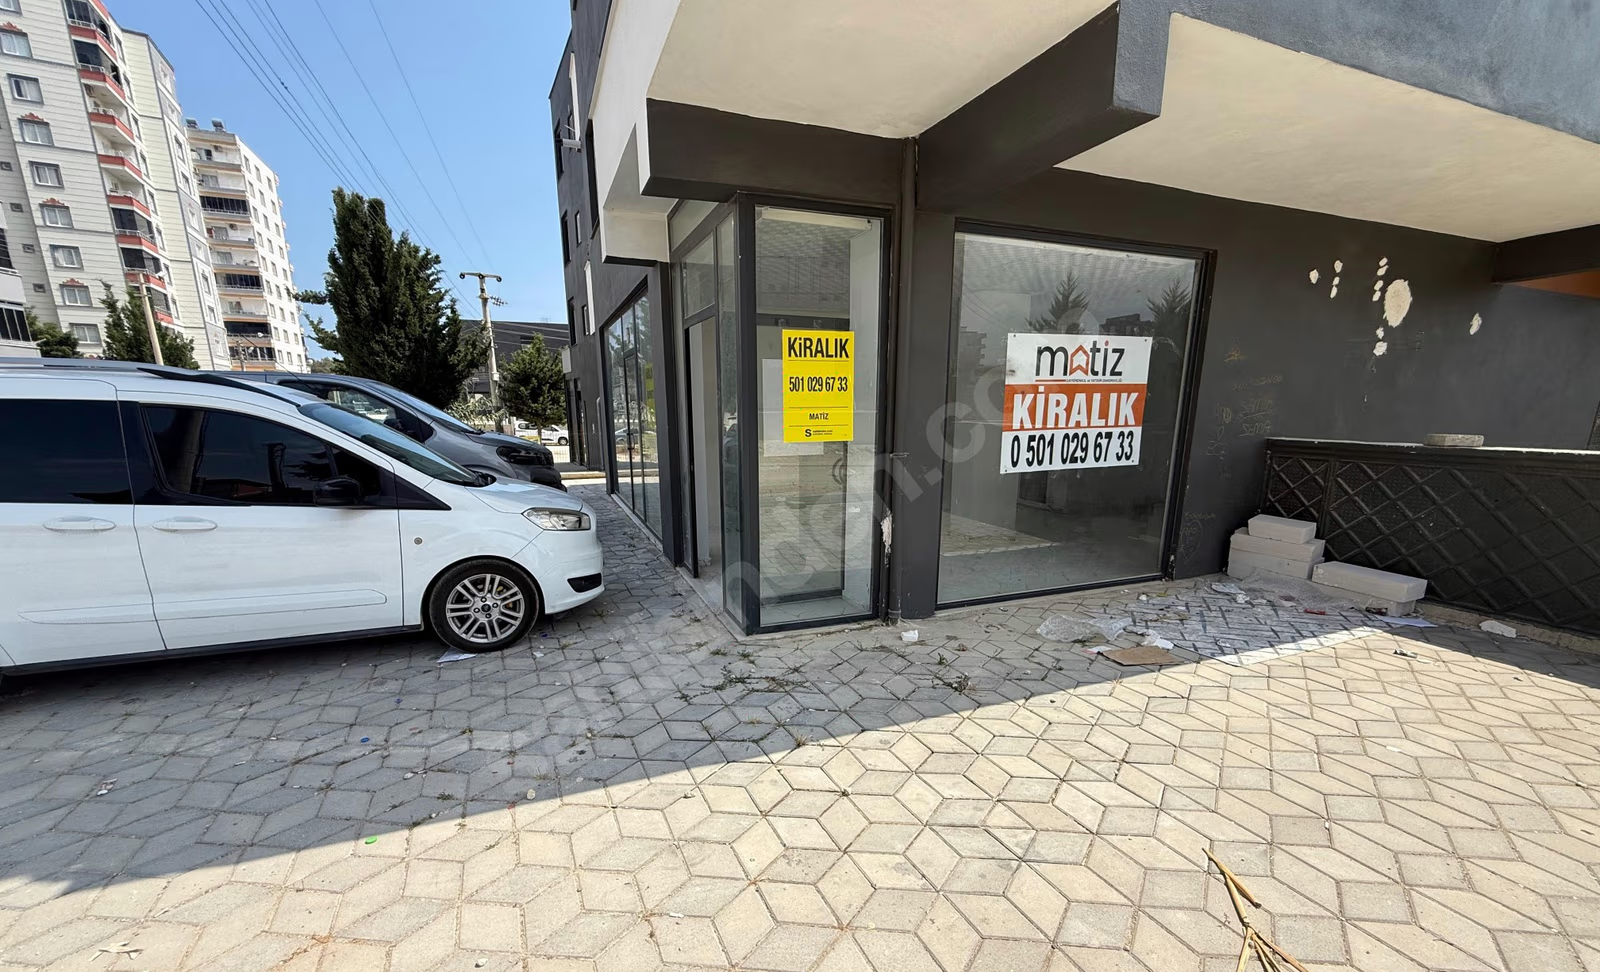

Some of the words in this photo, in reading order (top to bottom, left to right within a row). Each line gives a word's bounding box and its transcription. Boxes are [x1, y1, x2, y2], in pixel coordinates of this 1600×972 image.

[789, 376, 804, 392] 501
[807, 376, 823, 392] 029
[825, 376, 836, 392] 67
[838, 376, 848, 392] 33
[809, 412, 829, 420] MATİZ
[1012, 386, 1139, 430] KİRALIK
[1011, 434, 1020, 468] 0
[1026, 433, 1054, 466] 501
[1060, 432, 1088, 464] 029
[1094, 432, 1112, 462] 67
[1116, 430, 1134, 461] 33
